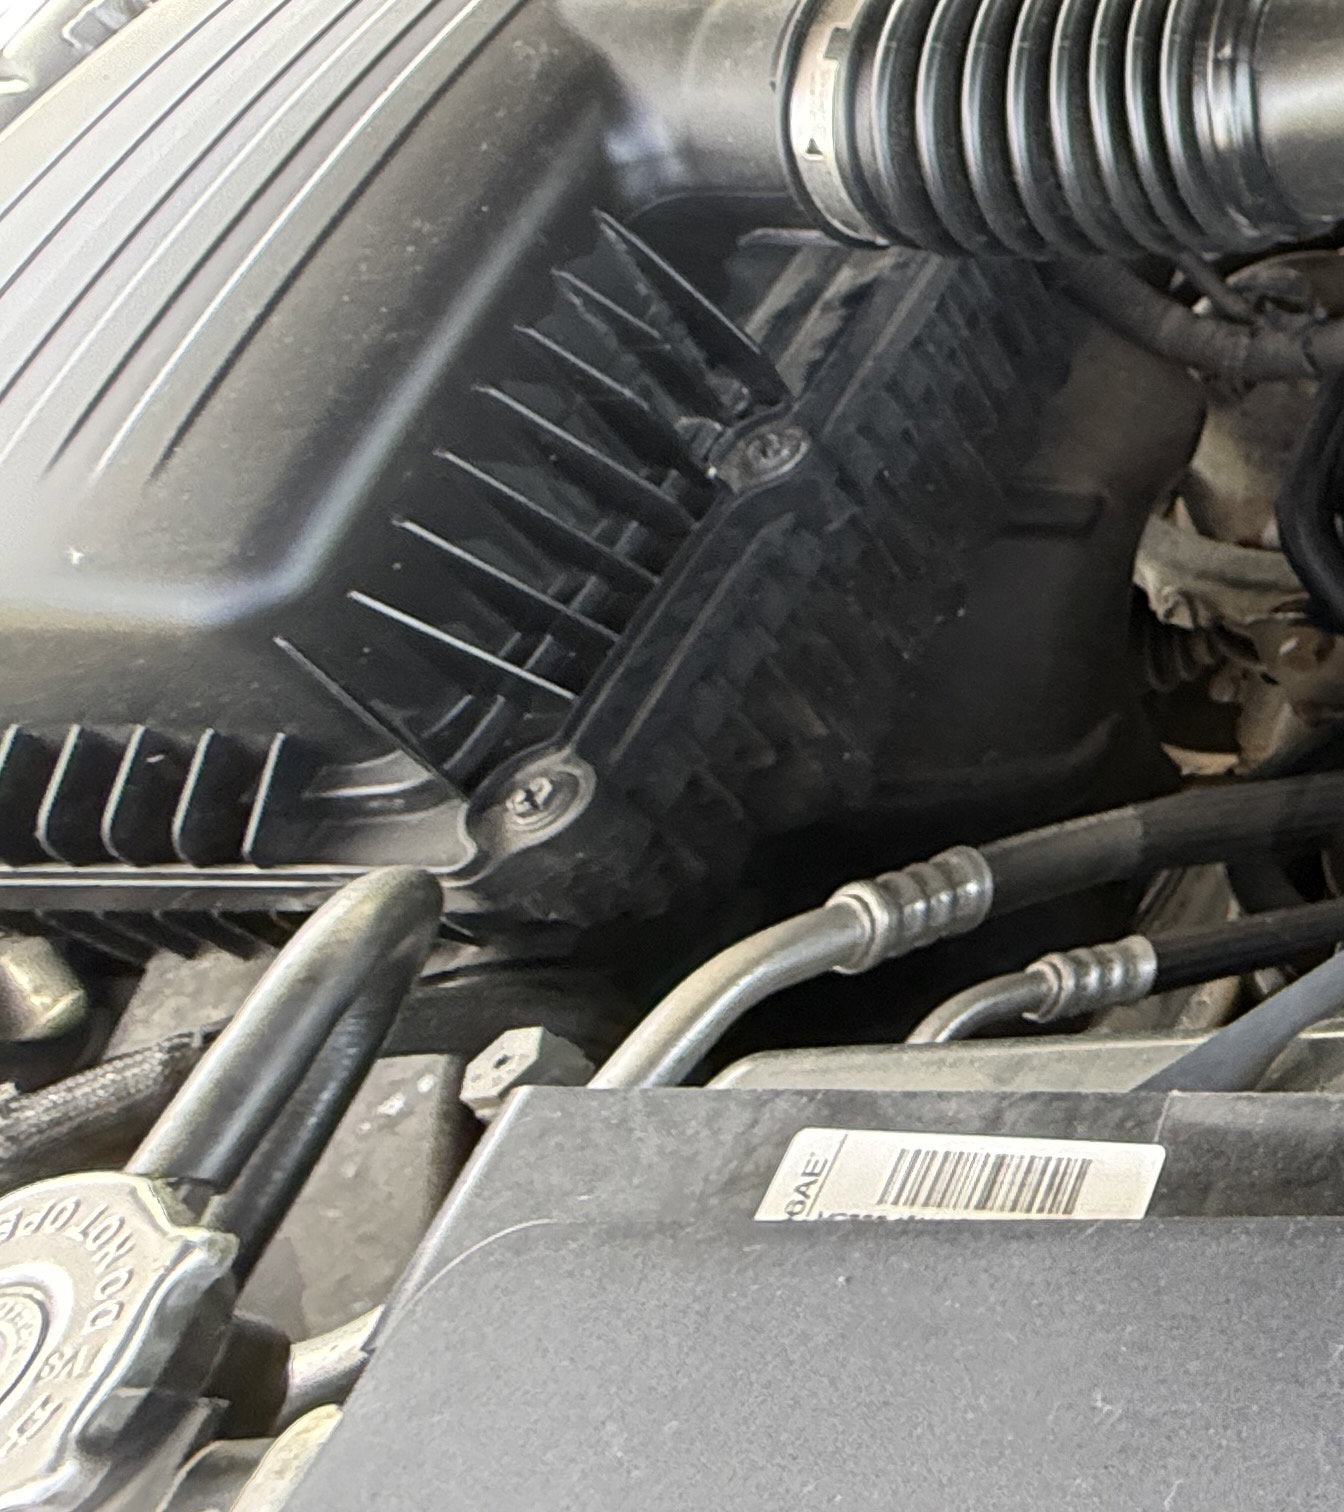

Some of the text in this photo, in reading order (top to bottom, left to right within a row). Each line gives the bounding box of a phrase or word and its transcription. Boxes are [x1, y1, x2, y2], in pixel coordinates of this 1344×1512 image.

[0, 1196, 82, 1244] OPE
[64, 1203, 137, 1274] NOT
[81, 1267, 135, 1335] DO
